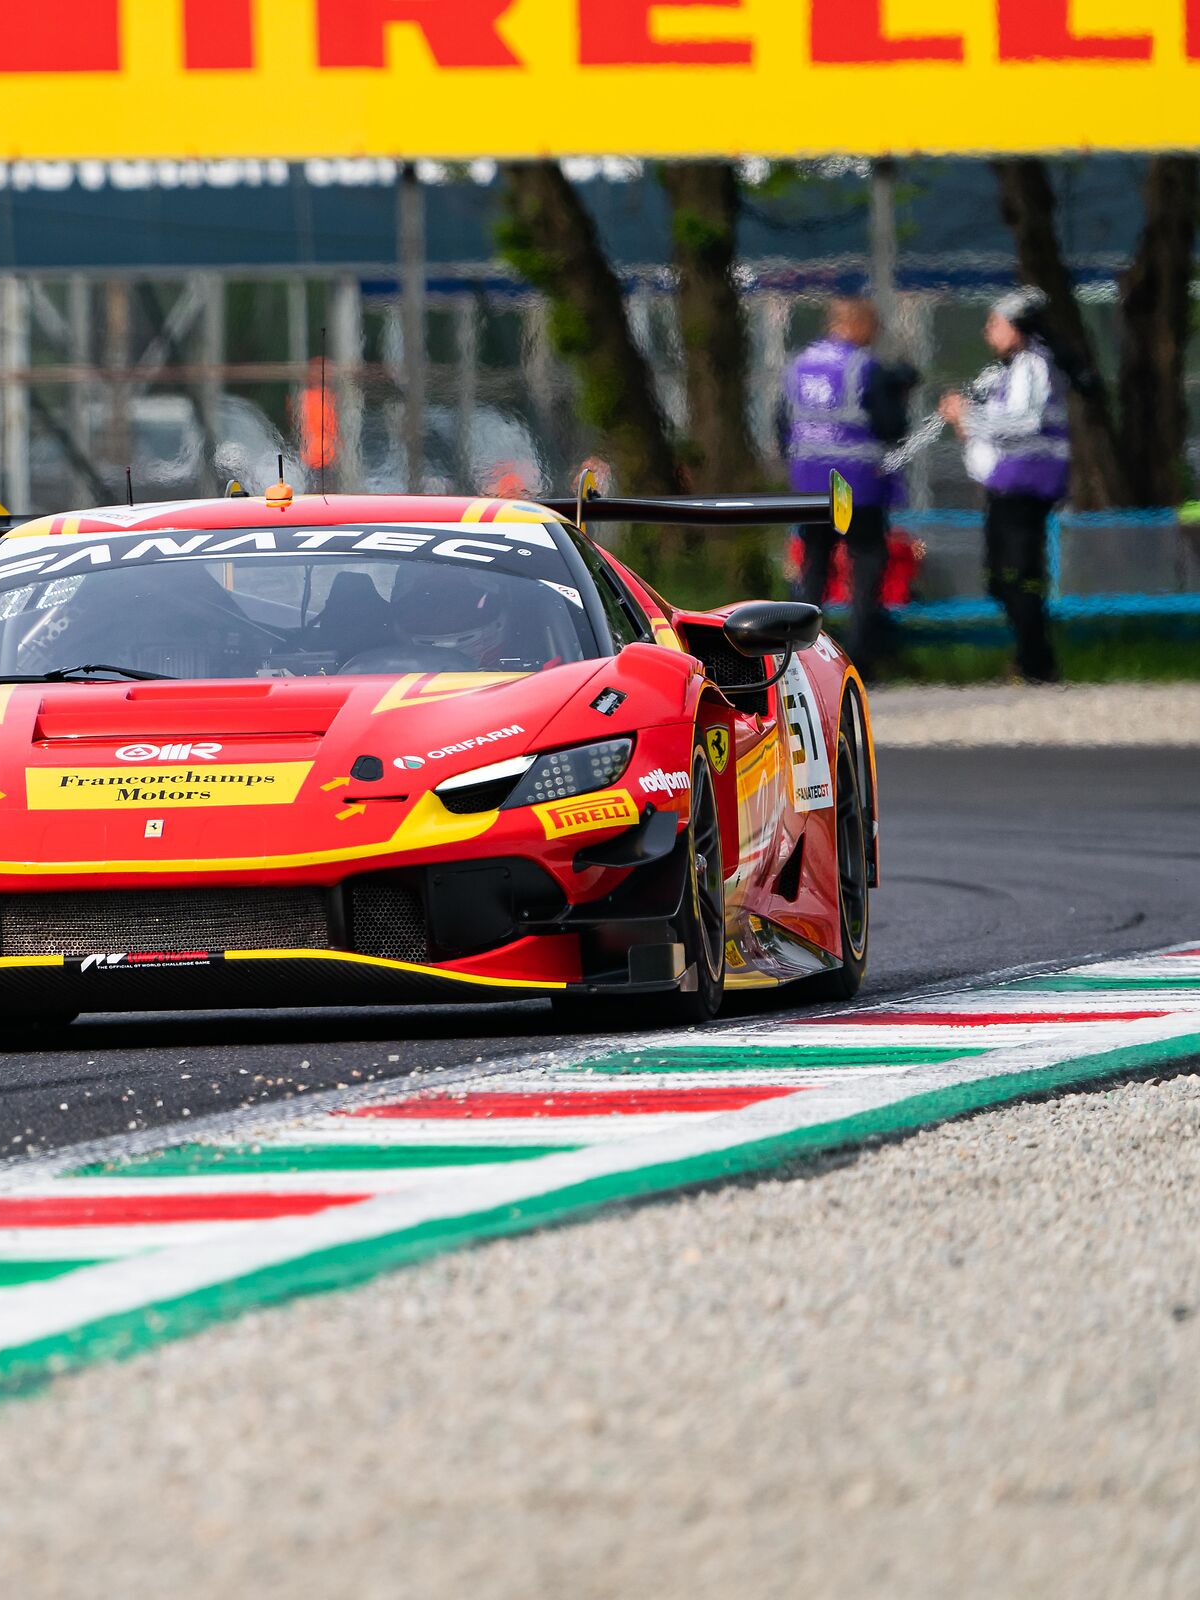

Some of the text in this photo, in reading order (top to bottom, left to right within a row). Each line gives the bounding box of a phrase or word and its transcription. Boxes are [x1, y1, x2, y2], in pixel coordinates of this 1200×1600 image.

[427, 724, 526, 759] ORIFARM
[783, 692, 818, 766] 51
[58, 770, 276, 788] Francorchamps
[115, 788, 211, 802] Motors
[546, 796, 631, 830] PIRELLI
